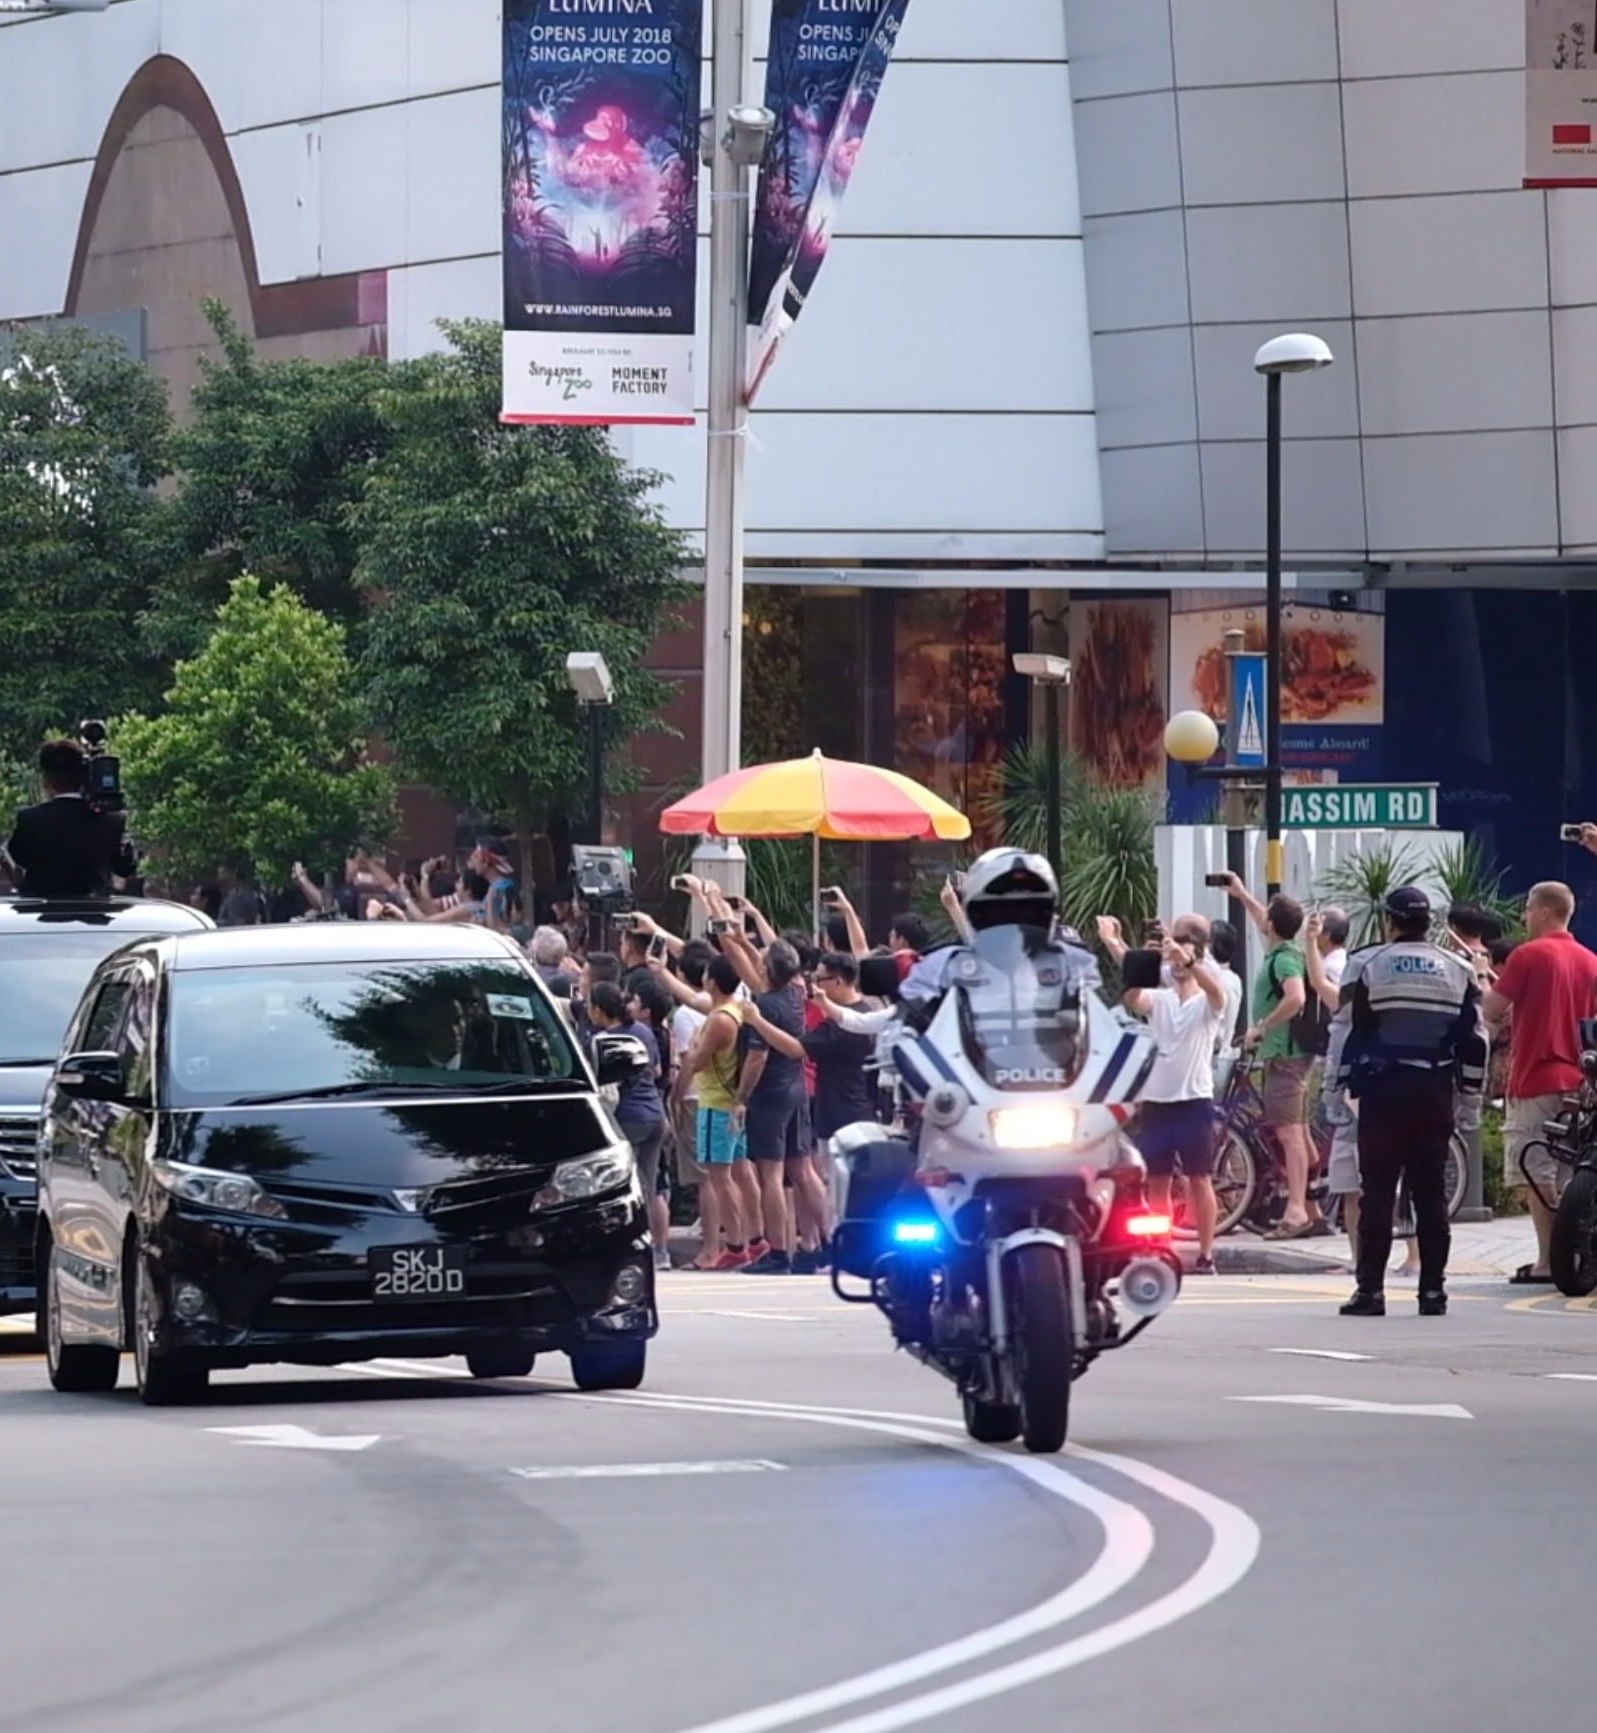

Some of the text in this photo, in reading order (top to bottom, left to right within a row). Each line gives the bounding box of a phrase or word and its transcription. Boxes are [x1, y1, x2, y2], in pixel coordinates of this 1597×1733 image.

[530, 25, 672, 44] OPENS JULY 2018
[800, 24, 853, 41] OPENS
[529, 46, 671, 64] SINGAPORE ZOO
[797, 44, 859, 61] SINGAP
[524, 303, 673, 318] WWW.RAINFORESTLUMINA.SG
[529, 360, 582, 386] Singapore
[612, 366, 668, 380] MOMENT
[563, 378, 592, 400] Zoo
[612, 381, 668, 394] FACTORY
[1388, 791, 1424, 821] RD
[1389, 955, 1445, 976] POLICE
[995, 1068, 1067, 1083] POLICE
[392, 1248, 443, 1272] SKJ
[375, 1269, 463, 1294] 2820D
